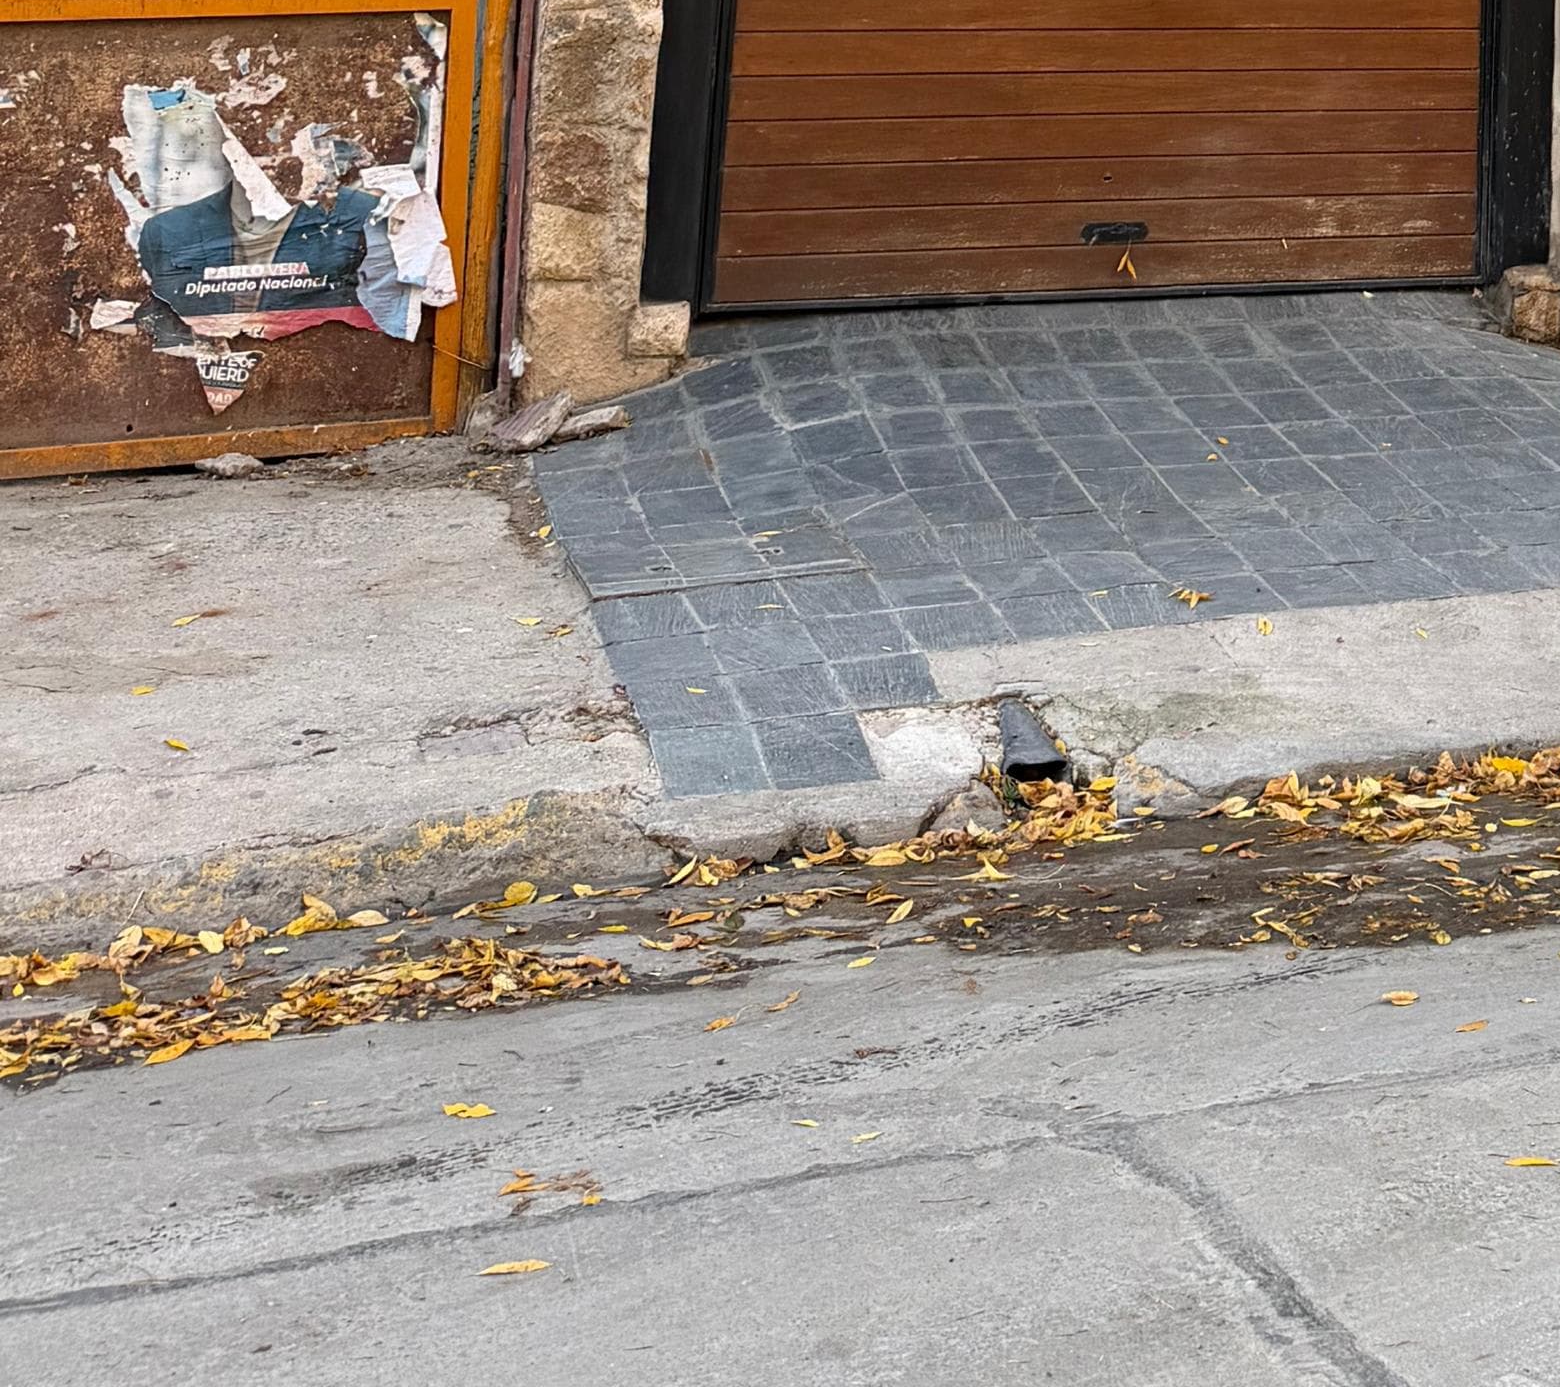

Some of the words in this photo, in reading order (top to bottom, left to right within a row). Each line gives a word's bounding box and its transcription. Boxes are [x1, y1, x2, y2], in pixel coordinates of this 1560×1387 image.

[203, 265, 265, 280] PABLO
[269, 262, 311, 277] VERA
[185, 279, 258, 297] Diputado
[200, 366, 250, 382] UIERD
